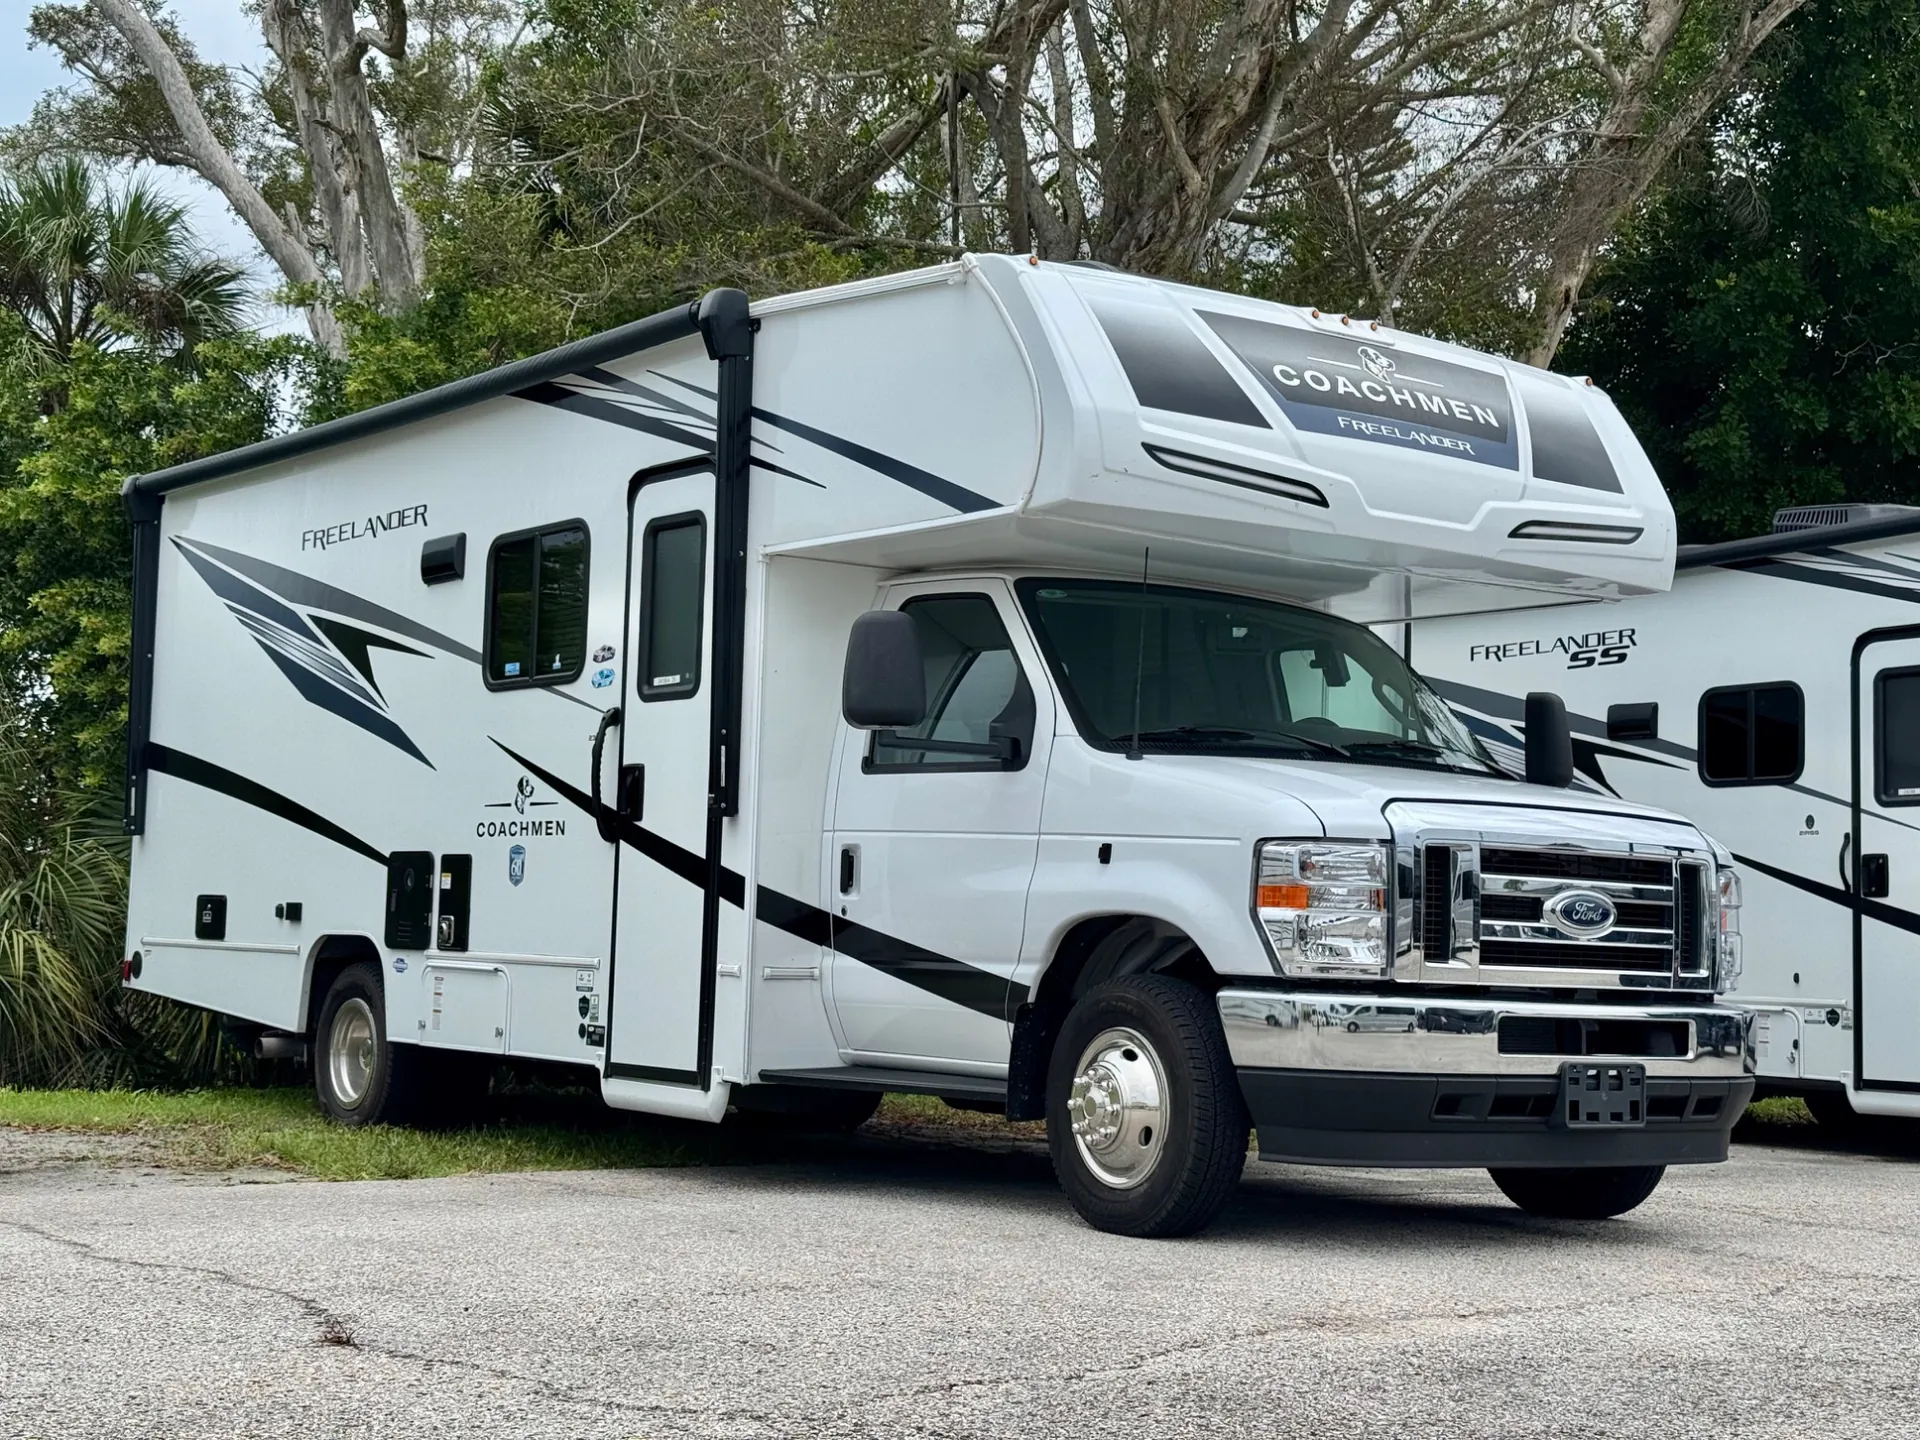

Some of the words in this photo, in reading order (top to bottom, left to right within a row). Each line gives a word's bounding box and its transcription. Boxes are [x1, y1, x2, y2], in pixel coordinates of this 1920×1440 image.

[1272, 364, 1500, 428] COACHMEN
[1337, 416, 1475, 455] FREELANDER
[302, 504, 428, 551] FREELANDER
[1470, 628, 1637, 662] FREELANDER
[1567, 645, 1630, 669] SS
[476, 820, 566, 837] COACHMEN
[1572, 901, 1603, 921] Ford
